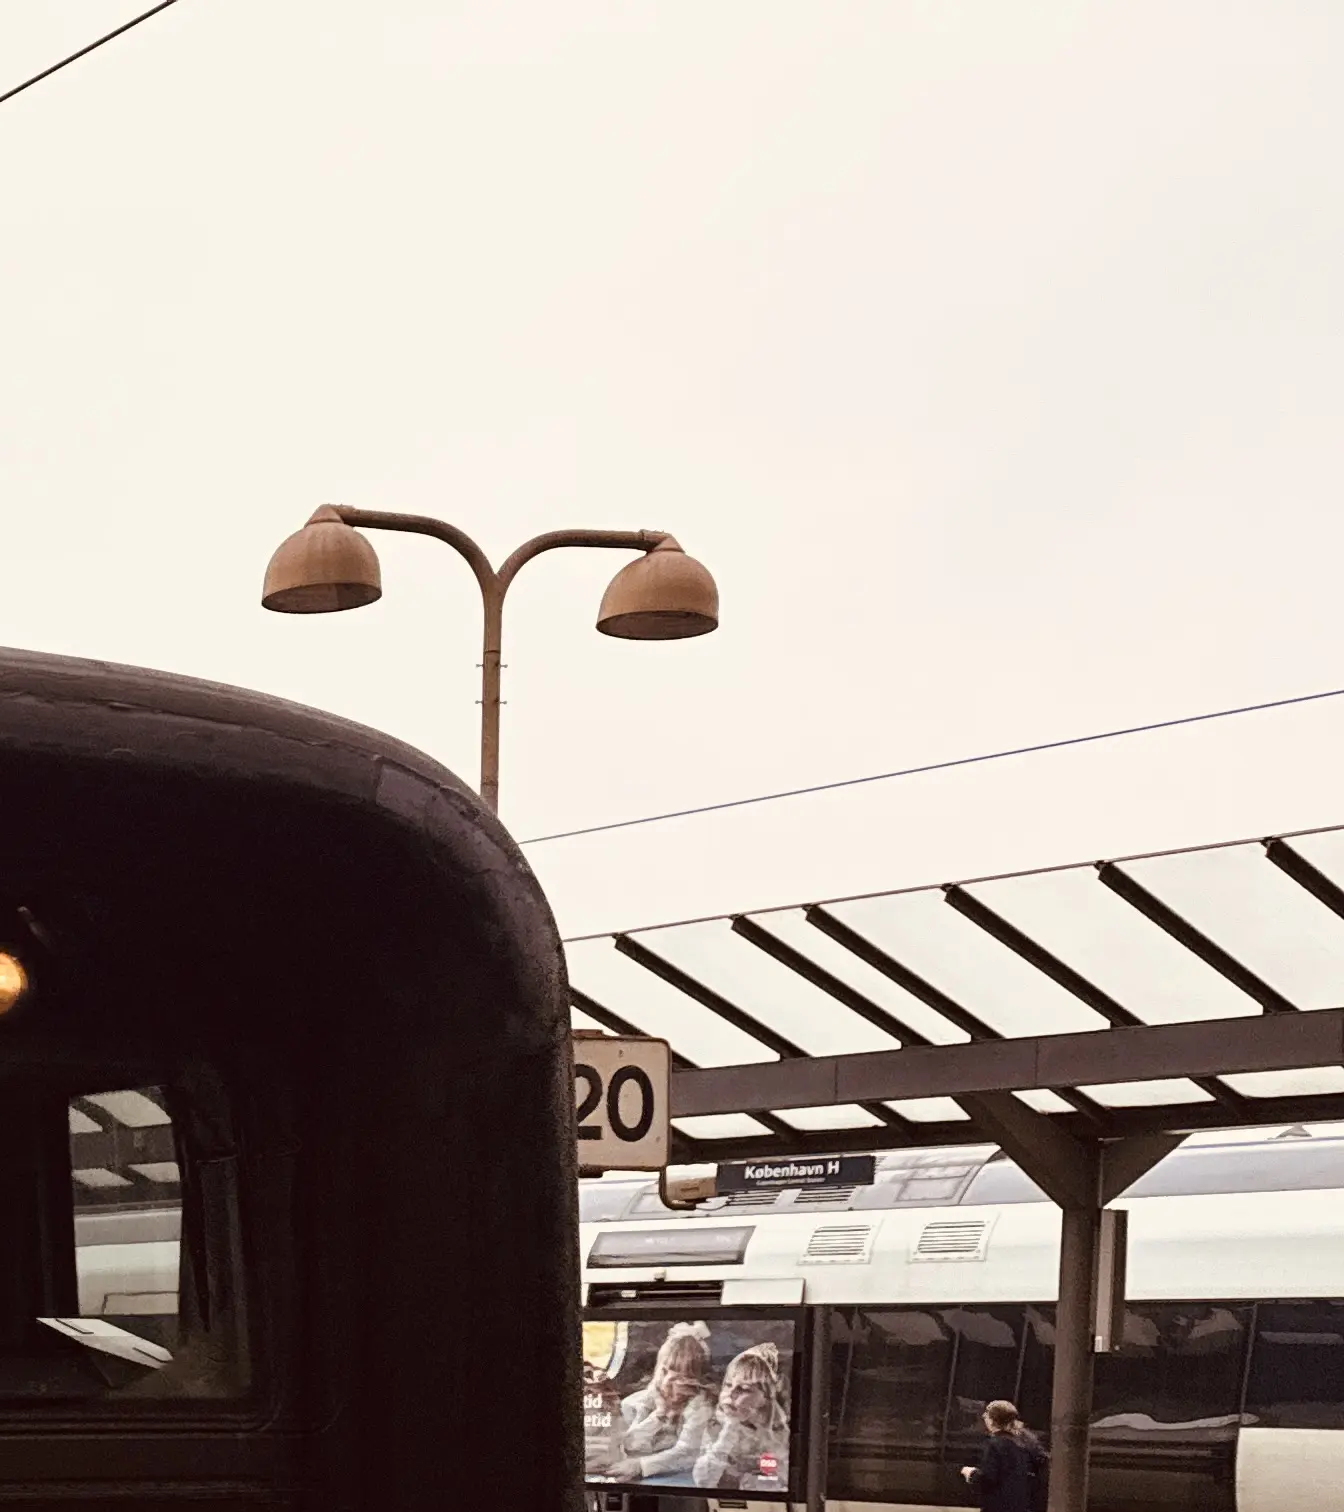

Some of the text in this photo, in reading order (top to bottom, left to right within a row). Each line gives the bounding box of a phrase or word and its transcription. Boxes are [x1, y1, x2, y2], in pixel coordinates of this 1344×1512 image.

[574, 1063, 655, 1143] 20
[744, 1160, 840, 1180] København H
